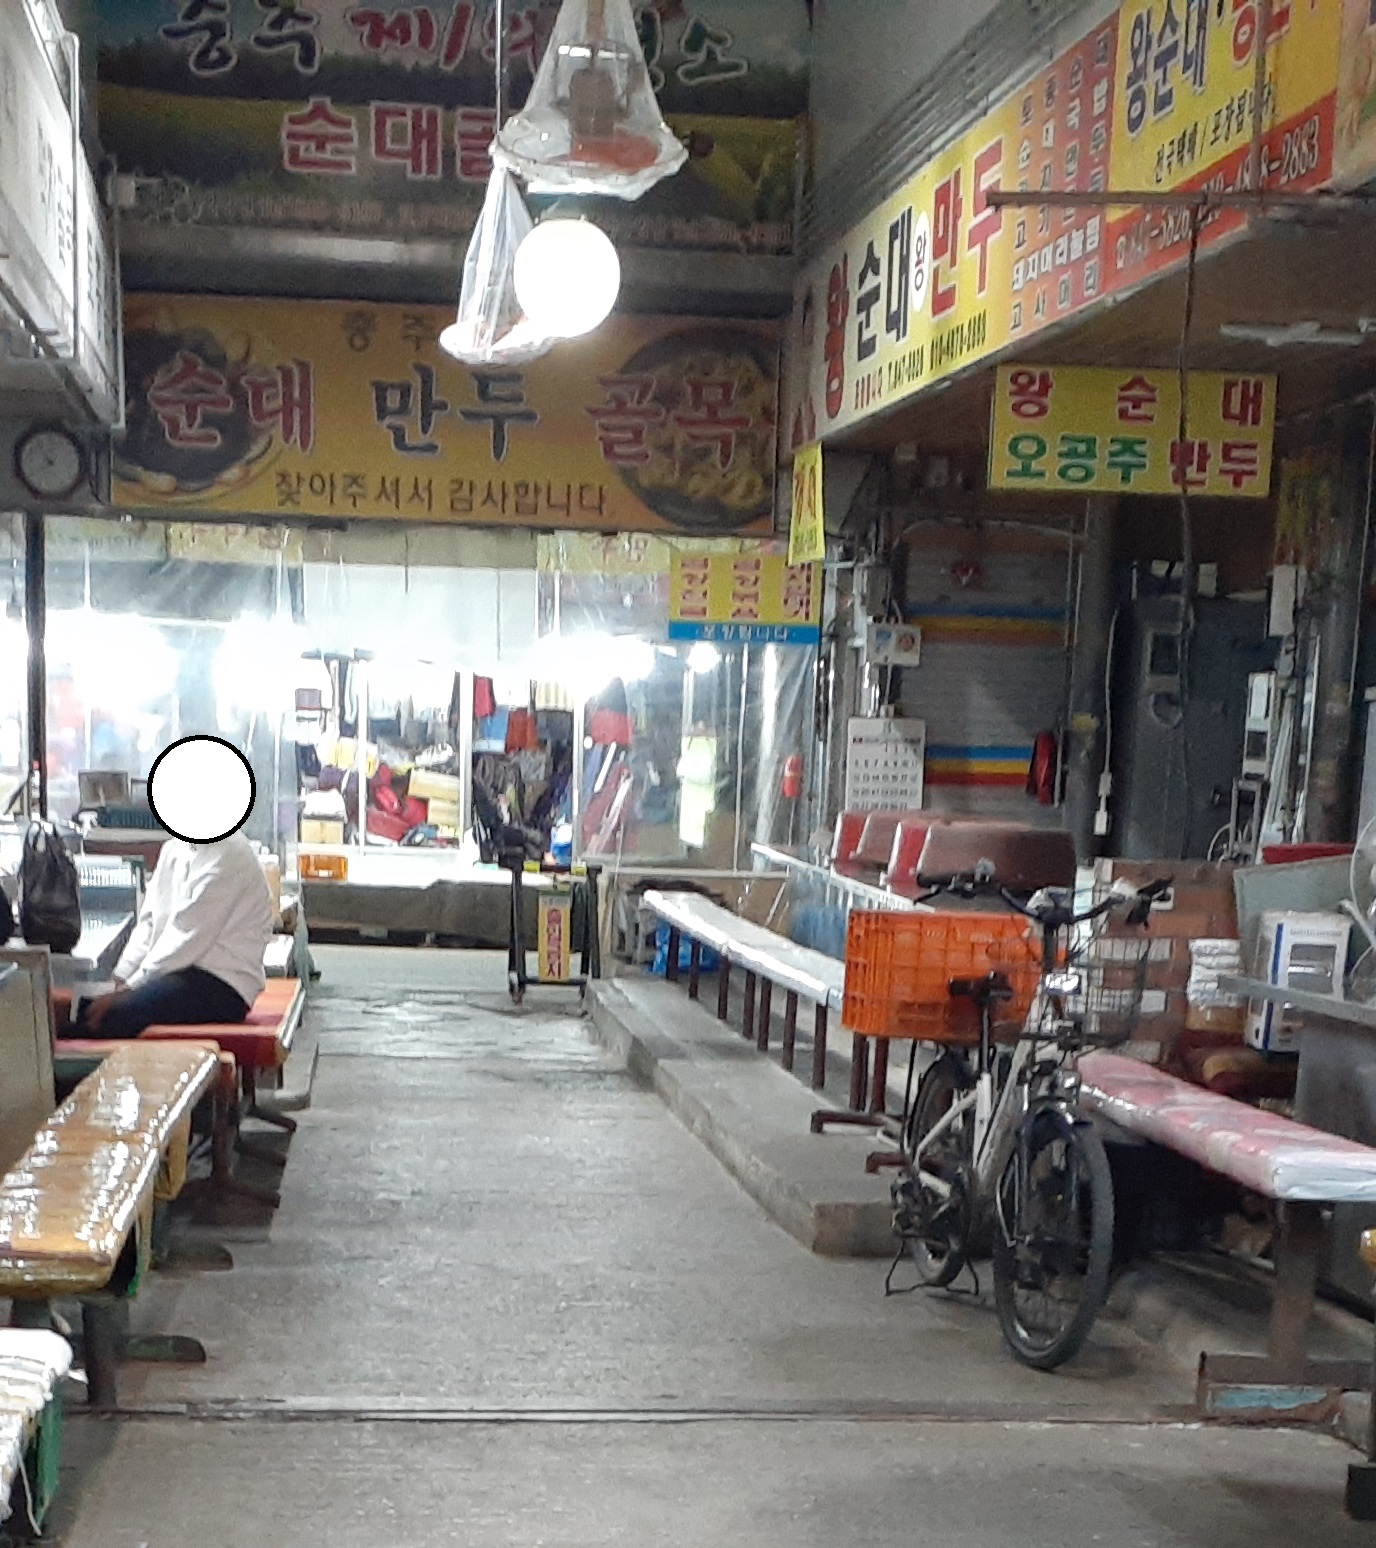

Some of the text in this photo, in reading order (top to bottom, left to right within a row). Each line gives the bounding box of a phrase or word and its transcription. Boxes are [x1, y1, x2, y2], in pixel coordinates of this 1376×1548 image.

[282, 98, 502, 180] 순대골
[856, 204, 912, 363] 순대
[931, 140, 1004, 318] 만두
[148, 352, 314, 455] 순대
[371, 362, 541, 462] 만두
[585, 373, 754, 472] 골목
[449, 478, 606, 518] 감사합니다
[1005, 432, 1261, 490] 오공주 만두
